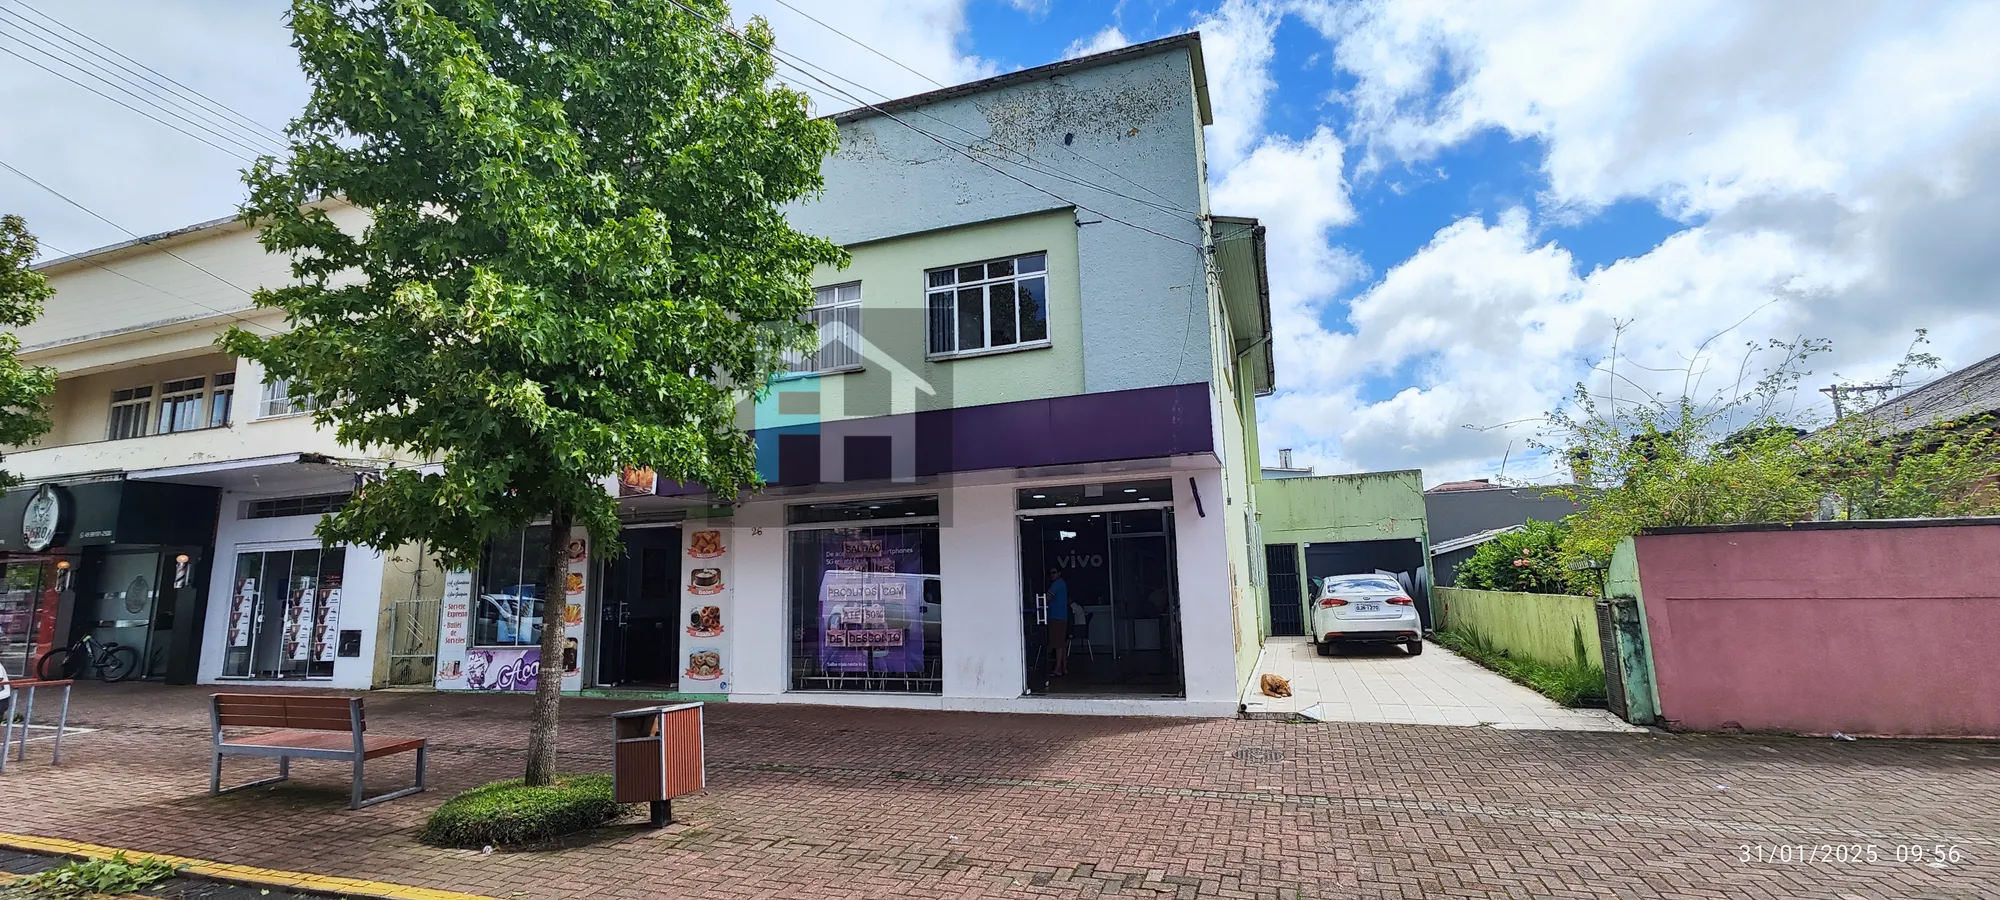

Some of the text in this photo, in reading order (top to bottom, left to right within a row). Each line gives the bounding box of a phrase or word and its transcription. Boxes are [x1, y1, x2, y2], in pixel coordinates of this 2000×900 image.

[751, 526, 762, 536] 26
[1056, 549, 1103, 568] vivo
[828, 586, 904, 597] PRODUTOS COM
[866, 610, 884, 619] 50%
[829, 633, 900, 644] DE DESCONTO
